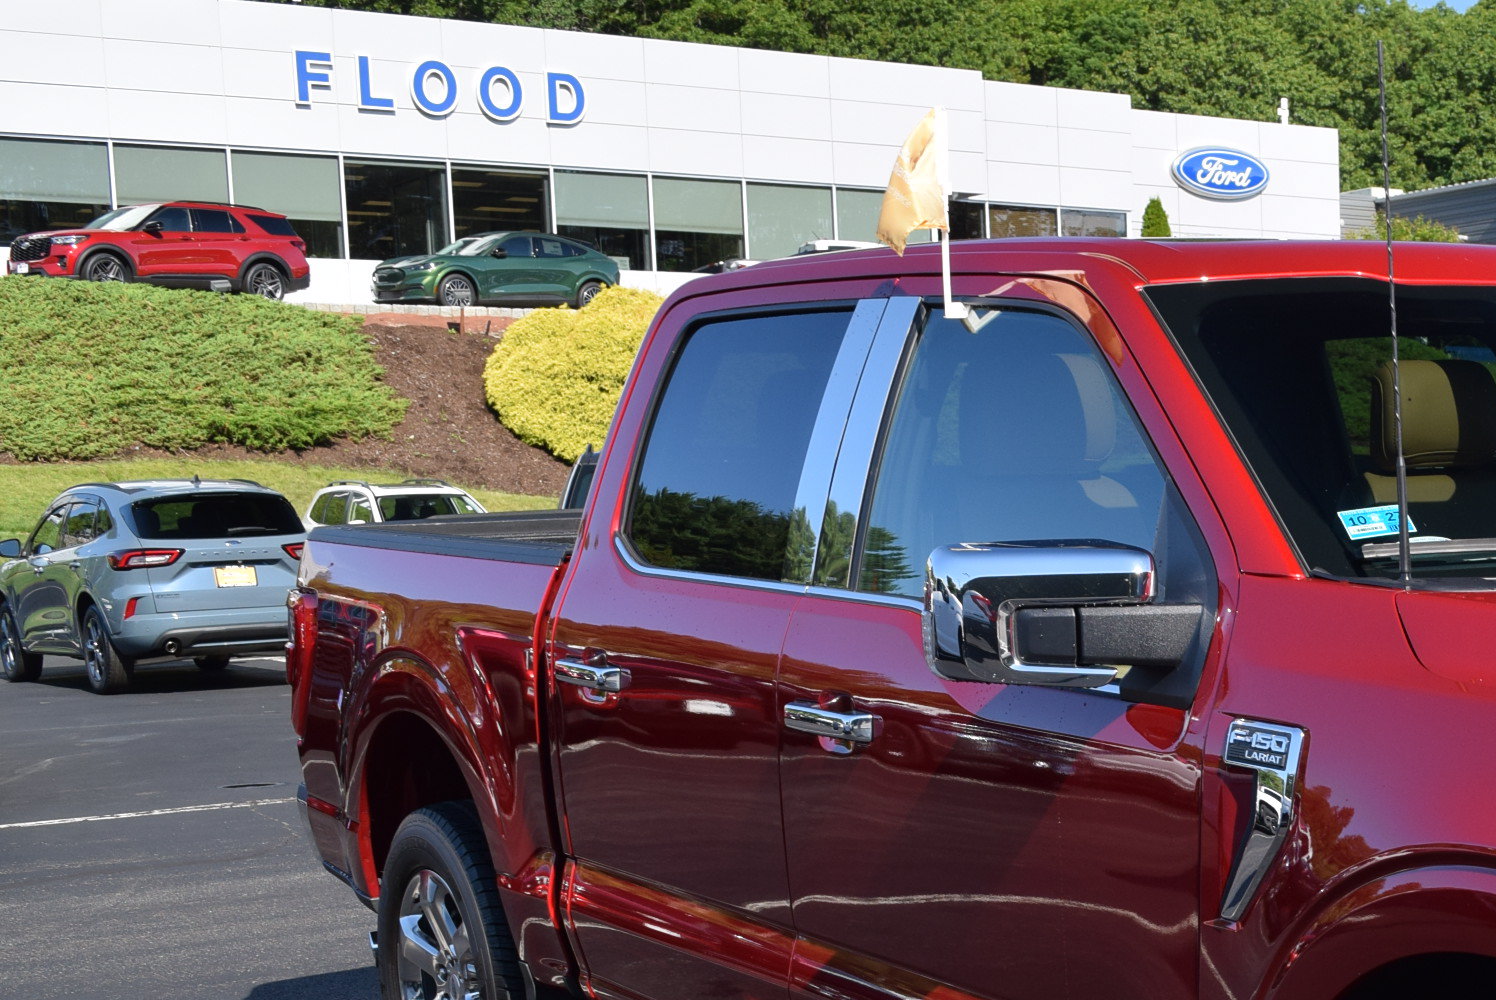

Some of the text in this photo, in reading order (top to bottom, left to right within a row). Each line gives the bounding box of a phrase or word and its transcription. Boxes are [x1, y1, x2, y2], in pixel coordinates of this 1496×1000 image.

[294, 50, 586, 124] FLOOD
[1197, 156, 1252, 187] Ford
[1348, 515, 1367, 527] 10
[1230, 729, 1288, 753] F-150
[1245, 750, 1282, 764] LARIAT
